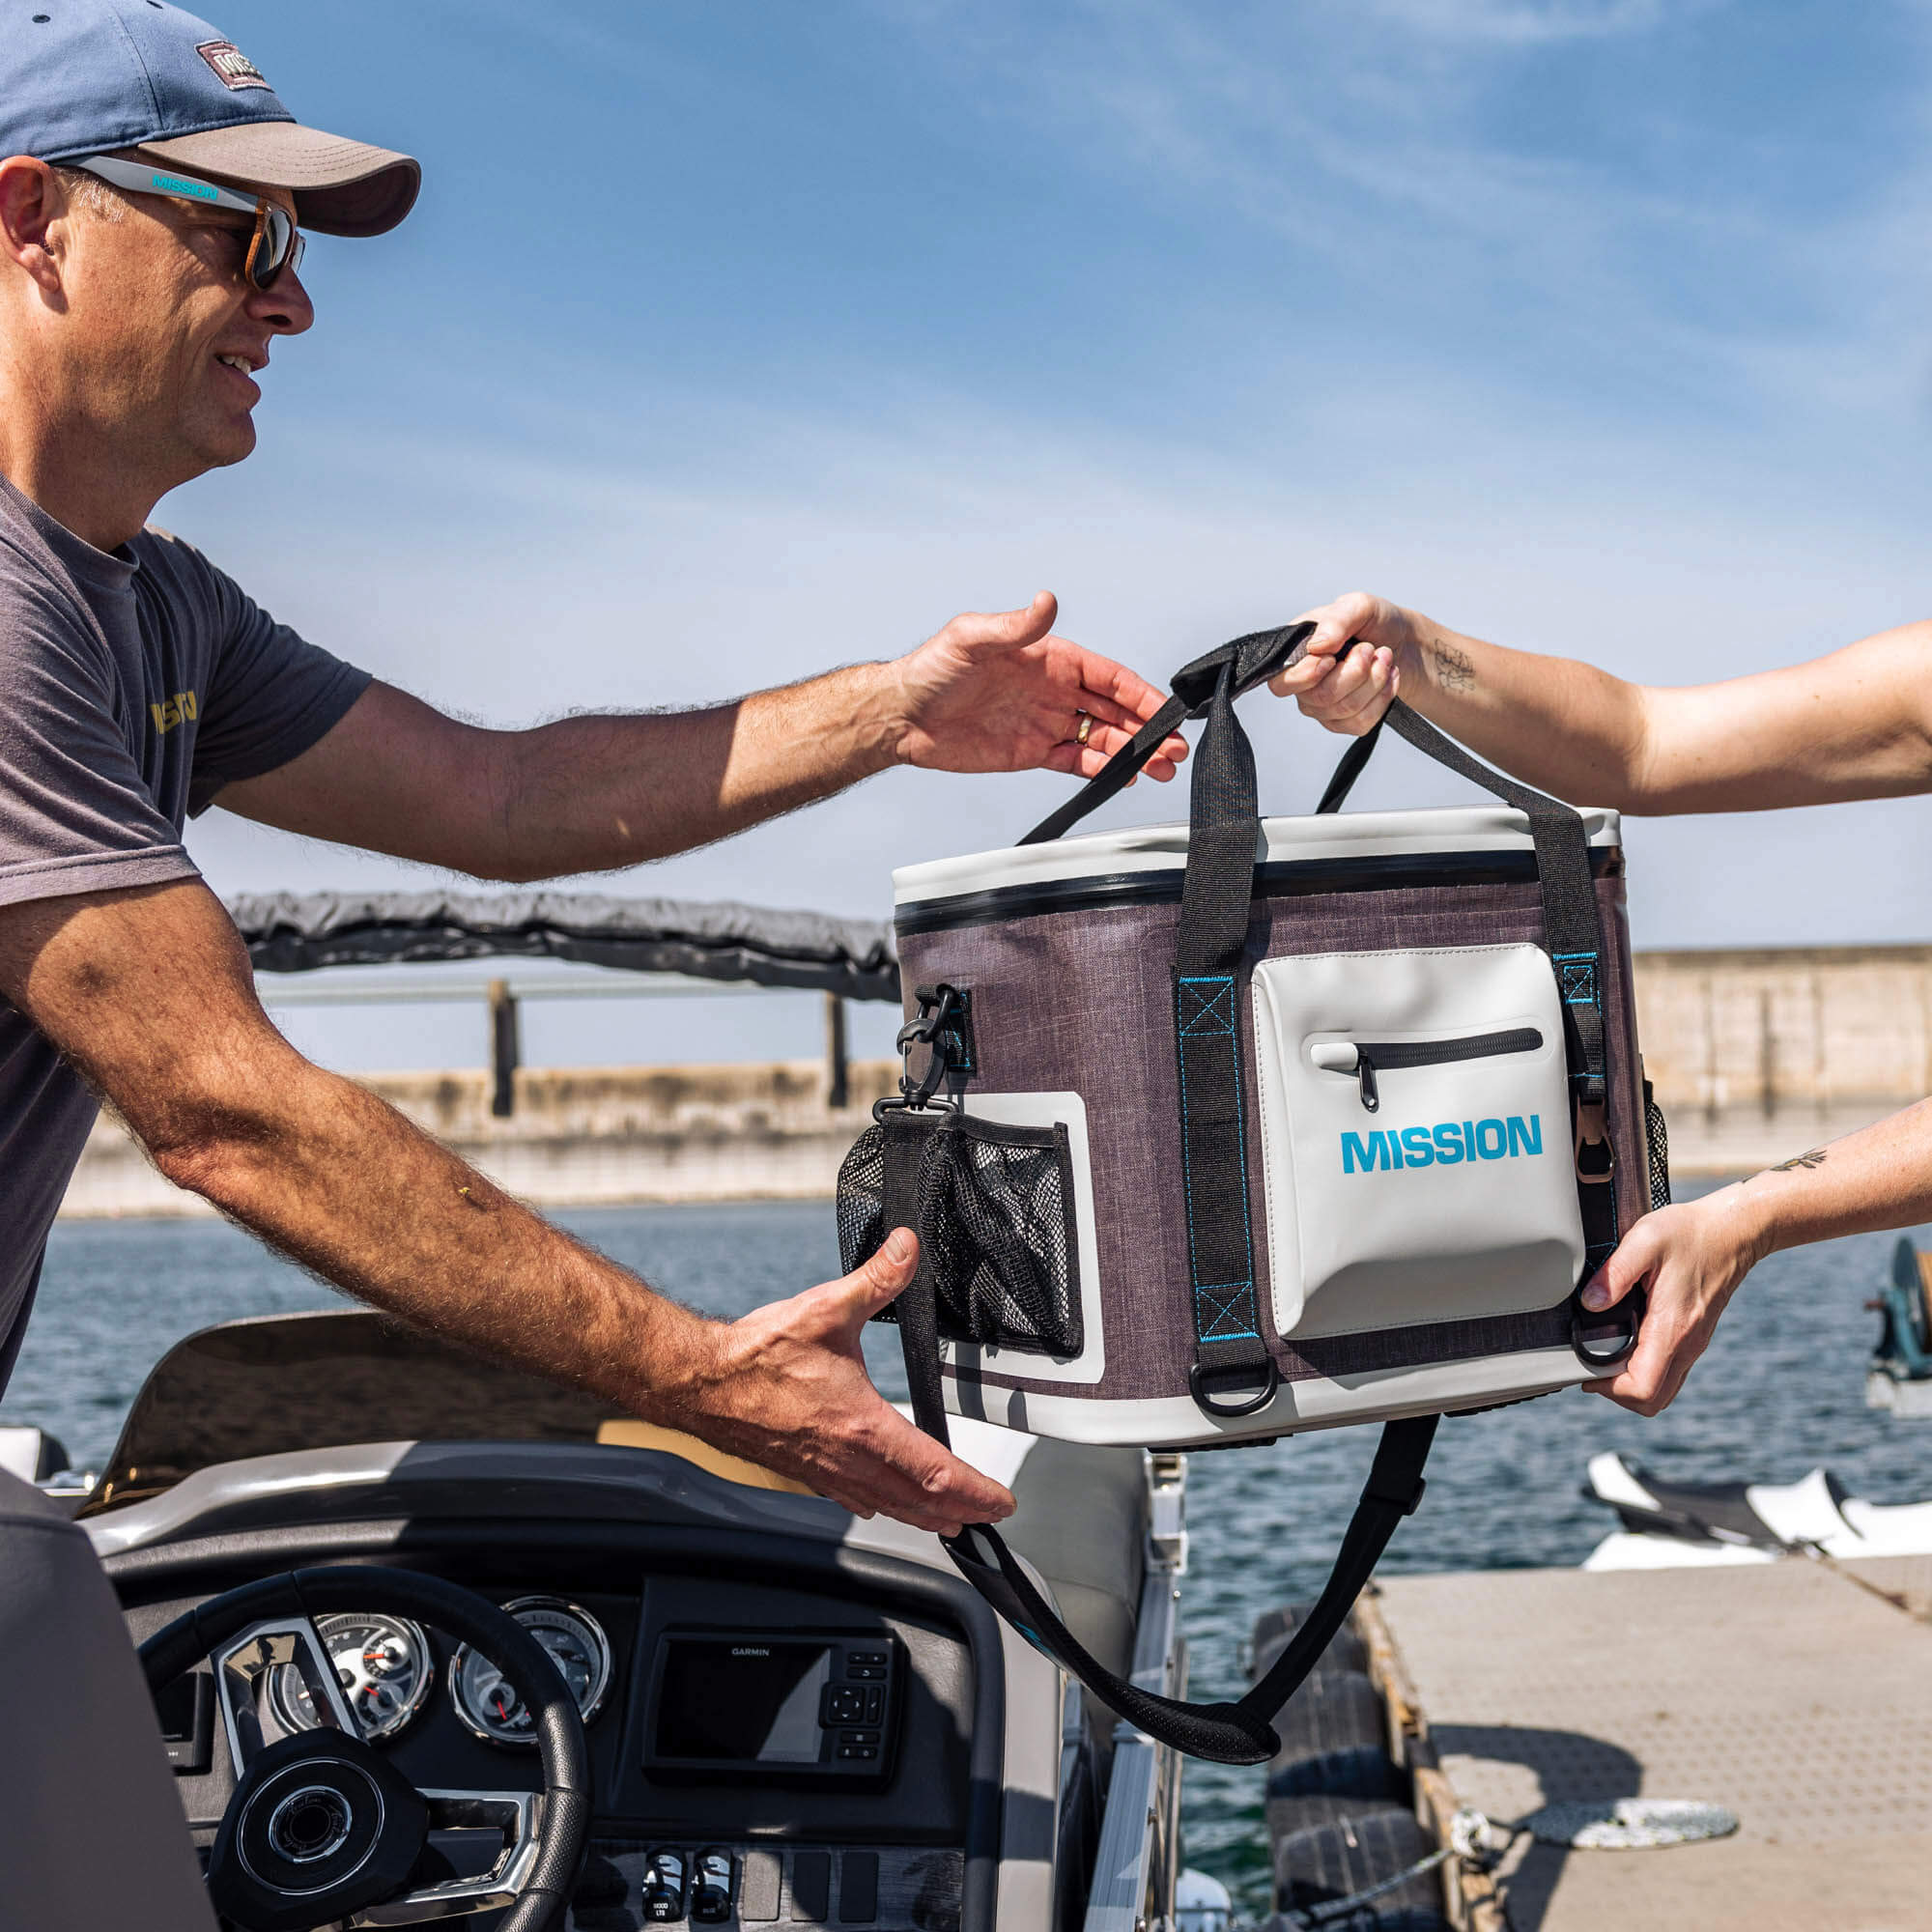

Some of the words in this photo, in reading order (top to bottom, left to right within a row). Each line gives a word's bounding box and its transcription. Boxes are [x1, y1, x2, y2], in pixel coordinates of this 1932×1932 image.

[153, 174, 218, 200] MISSION
[1340, 1114, 1543, 1175] MISSION
[731, 1647, 770, 1656] GARMIN
